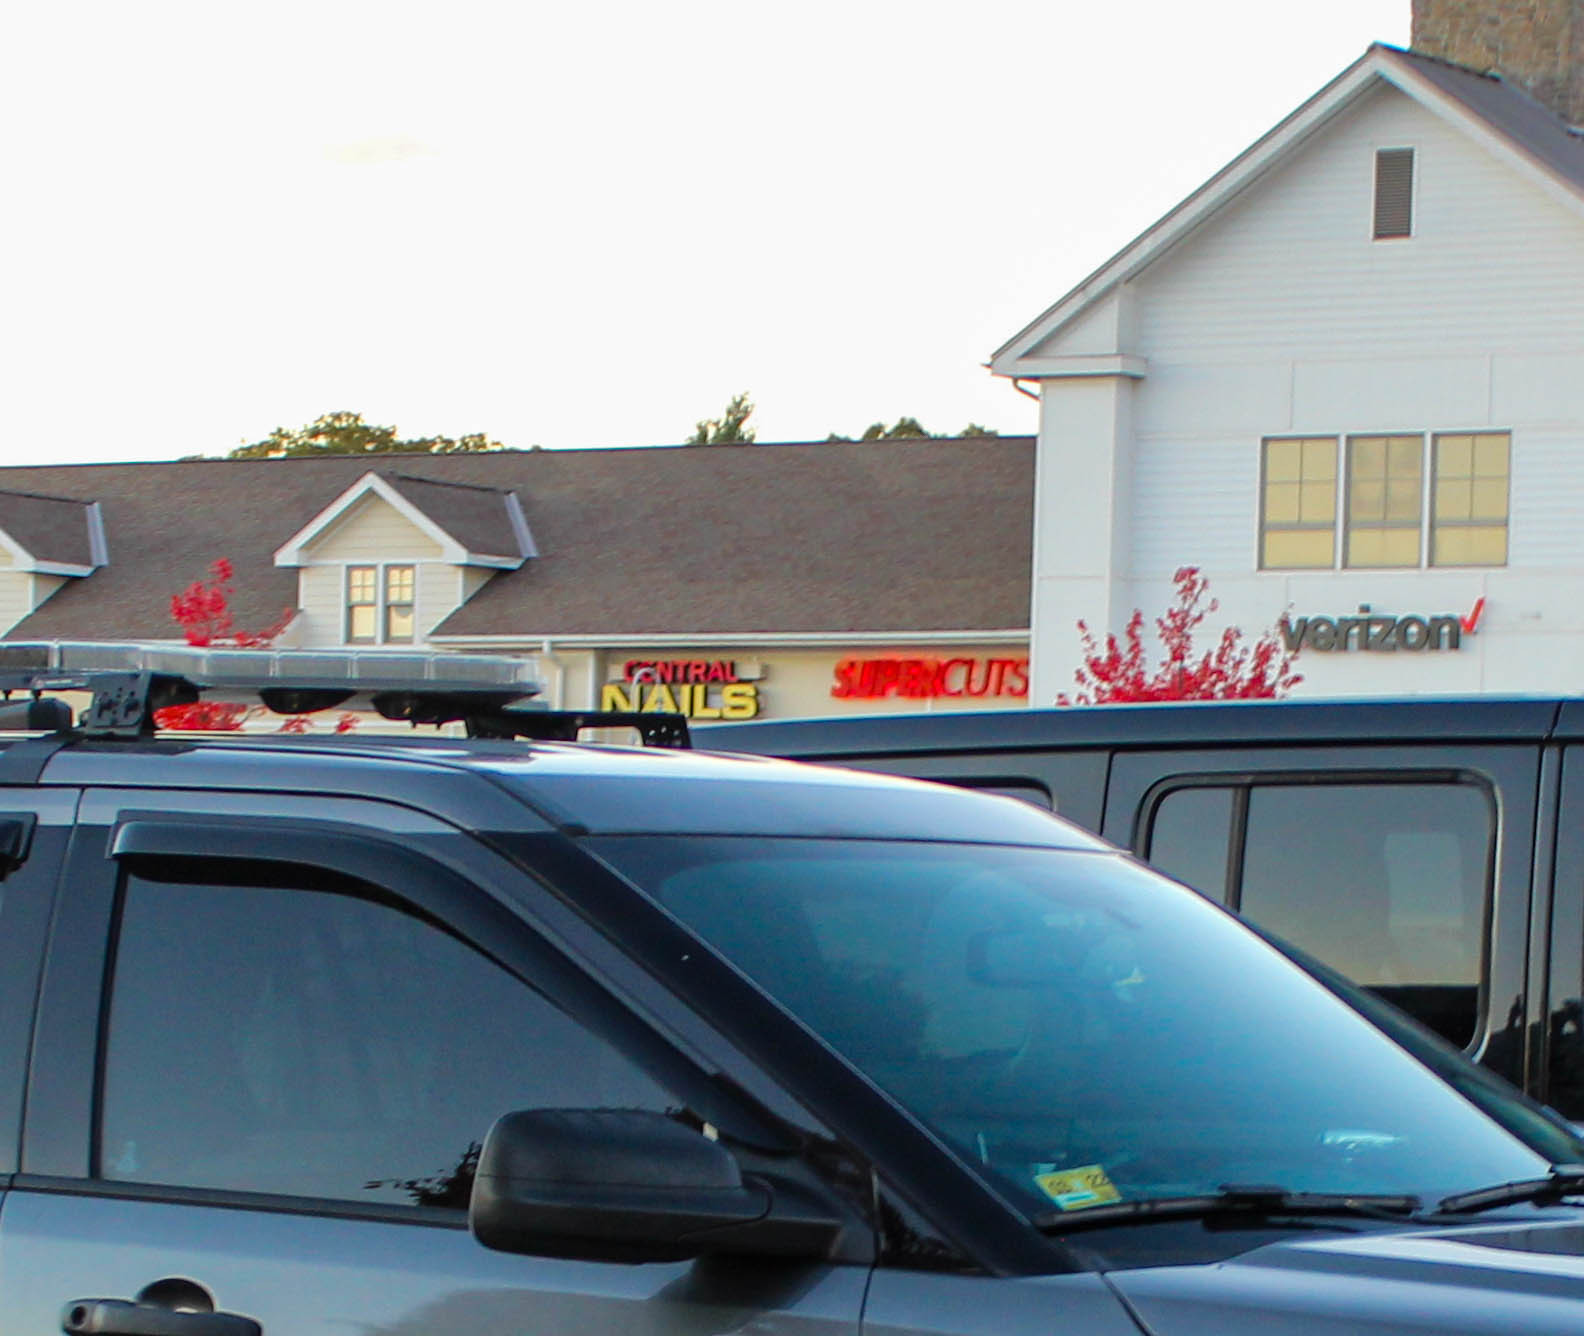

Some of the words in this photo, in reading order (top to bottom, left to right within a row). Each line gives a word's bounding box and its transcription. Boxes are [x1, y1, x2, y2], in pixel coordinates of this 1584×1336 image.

[1281, 603, 1461, 651] verizon
[624, 659, 738, 683] CENTRAL
[830, 658, 1029, 698] SUPERCUTS
[601, 683, 759, 719] NAILS
